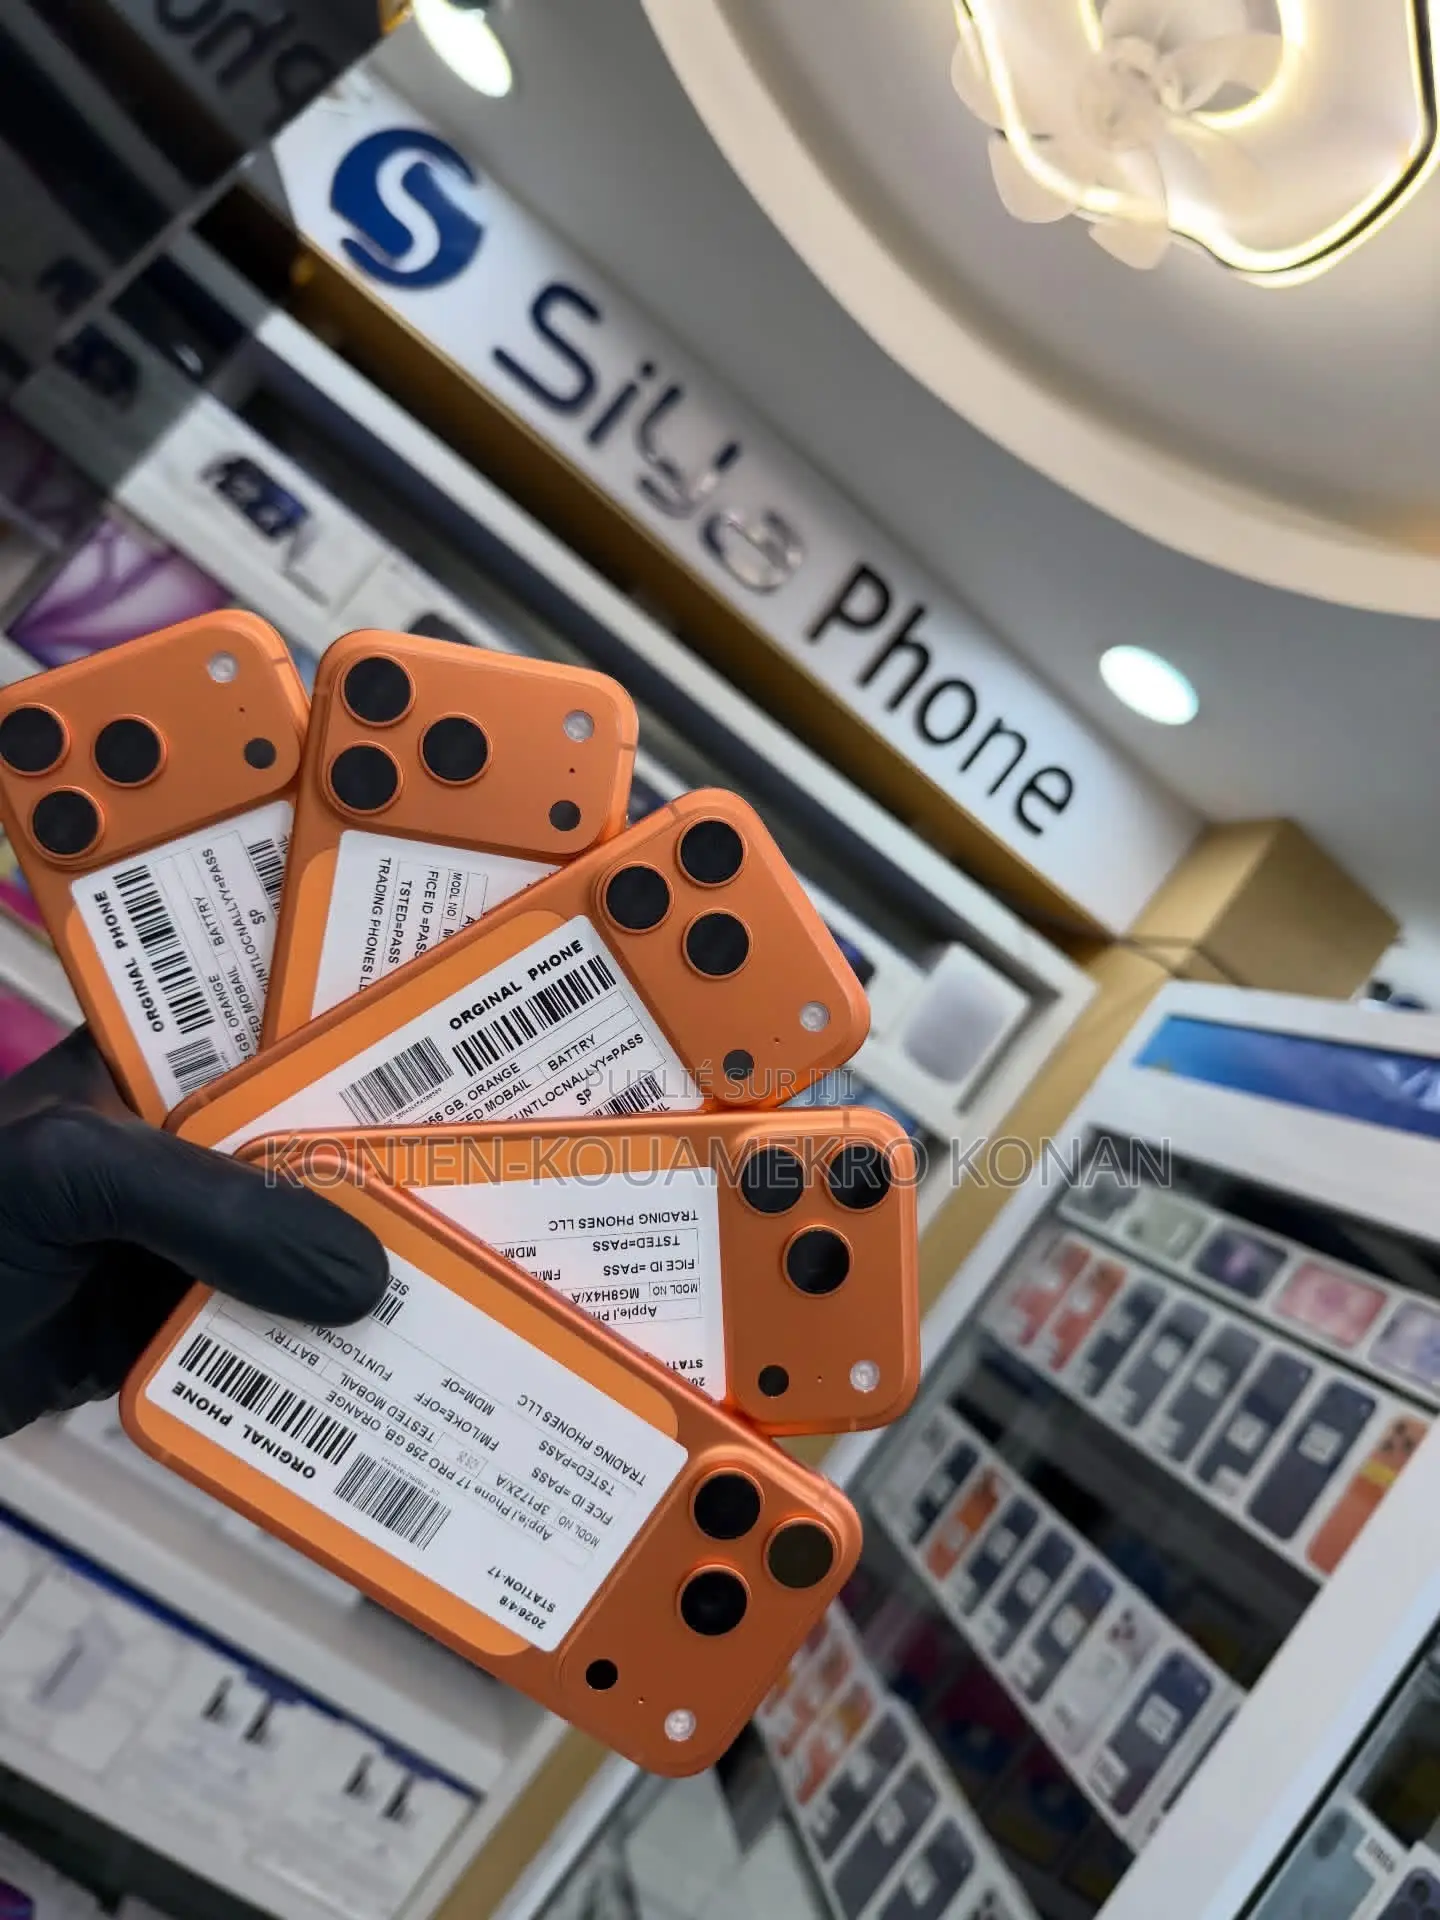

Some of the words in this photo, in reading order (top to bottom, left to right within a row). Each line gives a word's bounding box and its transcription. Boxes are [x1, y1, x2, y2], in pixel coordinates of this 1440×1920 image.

[808, 563, 1076, 836] Phone
[371, 857, 391, 915] TRADING
[423, 870, 439, 899] FICE
[448, 872, 463, 899] MODL
[93, 890, 128, 949] PHONE
[193, 896, 225, 946] BATTRY
[248, 908, 267, 925] SP
[387, 880, 412, 964] TSTED=PASS
[421, 901, 434, 914] ID
[446, 901, 458, 917] NO
[361, 918, 381, 973] PHONES
[124, 957, 164, 1032] ORGINAL
[227, 966, 256, 1014] MOBAIL
[449, 981, 522, 1030] ORGINAL
[527, 939, 583, 981] PHONE
[208, 974, 239, 1028] ORANGE
[546, 1033, 595, 1071] BATTRY
[444, 1098, 468, 1116] GB,
[467, 1062, 521, 1101] ORANGE
[483, 1079, 532, 1112] MOBAIL
[575, 1087, 592, 1106] SP
[548, 1218, 574, 1231] LLC
[578, 1215, 634, 1229] PHONES
[638, 1209, 699, 1225] TRADING
[592, 1235, 680, 1252] TSTED=PASS
[602, 1263, 646, 1276] =PASS
[649, 1260, 663, 1272] ID
[665, 1258, 695, 1271] FICE
[569, 1287, 639, 1305] MG8H4X/A
[652, 1285, 667, 1296] NO
[669, 1283, 698, 1294] MODL
[264, 1322, 320, 1366] BATTRY
[666, 1358, 703, 1371] STAT
[171, 1381, 233, 1426] PHONE
[339, 1372, 387, 1410] MOBAIL
[440, 1377, 495, 1416] MDM=OF
[516, 1394, 543, 1417] LLC
[325, 1389, 381, 1431] ORANGE
[386, 1405, 435, 1443] TESTED
[413, 1392, 499, 1451] FM/LOKE=OFF
[384, 1424, 405, 1446] GB,
[541, 1411, 594, 1450] PHONES
[242, 1423, 316, 1479] ORGINAL
[405, 1442, 429, 1462] 256
[593, 1445, 646, 1486] TRADING
[428, 1457, 456, 1480] PRO
[530, 1466, 571, 1496] =PASS
[538, 1439, 614, 1496] TSTED=PASS
[455, 1476, 472, 1490] 17
[495, 1473, 550, 1515] 3P172X/A
[474, 1486, 512, 1516] Phone
[571, 1493, 586, 1508] ID
[584, 1501, 613, 1526] FICE
[557, 1515, 574, 1530] NO
[574, 1524, 600, 1548] MODL
[487, 1566, 556, 1613] STATION-17
